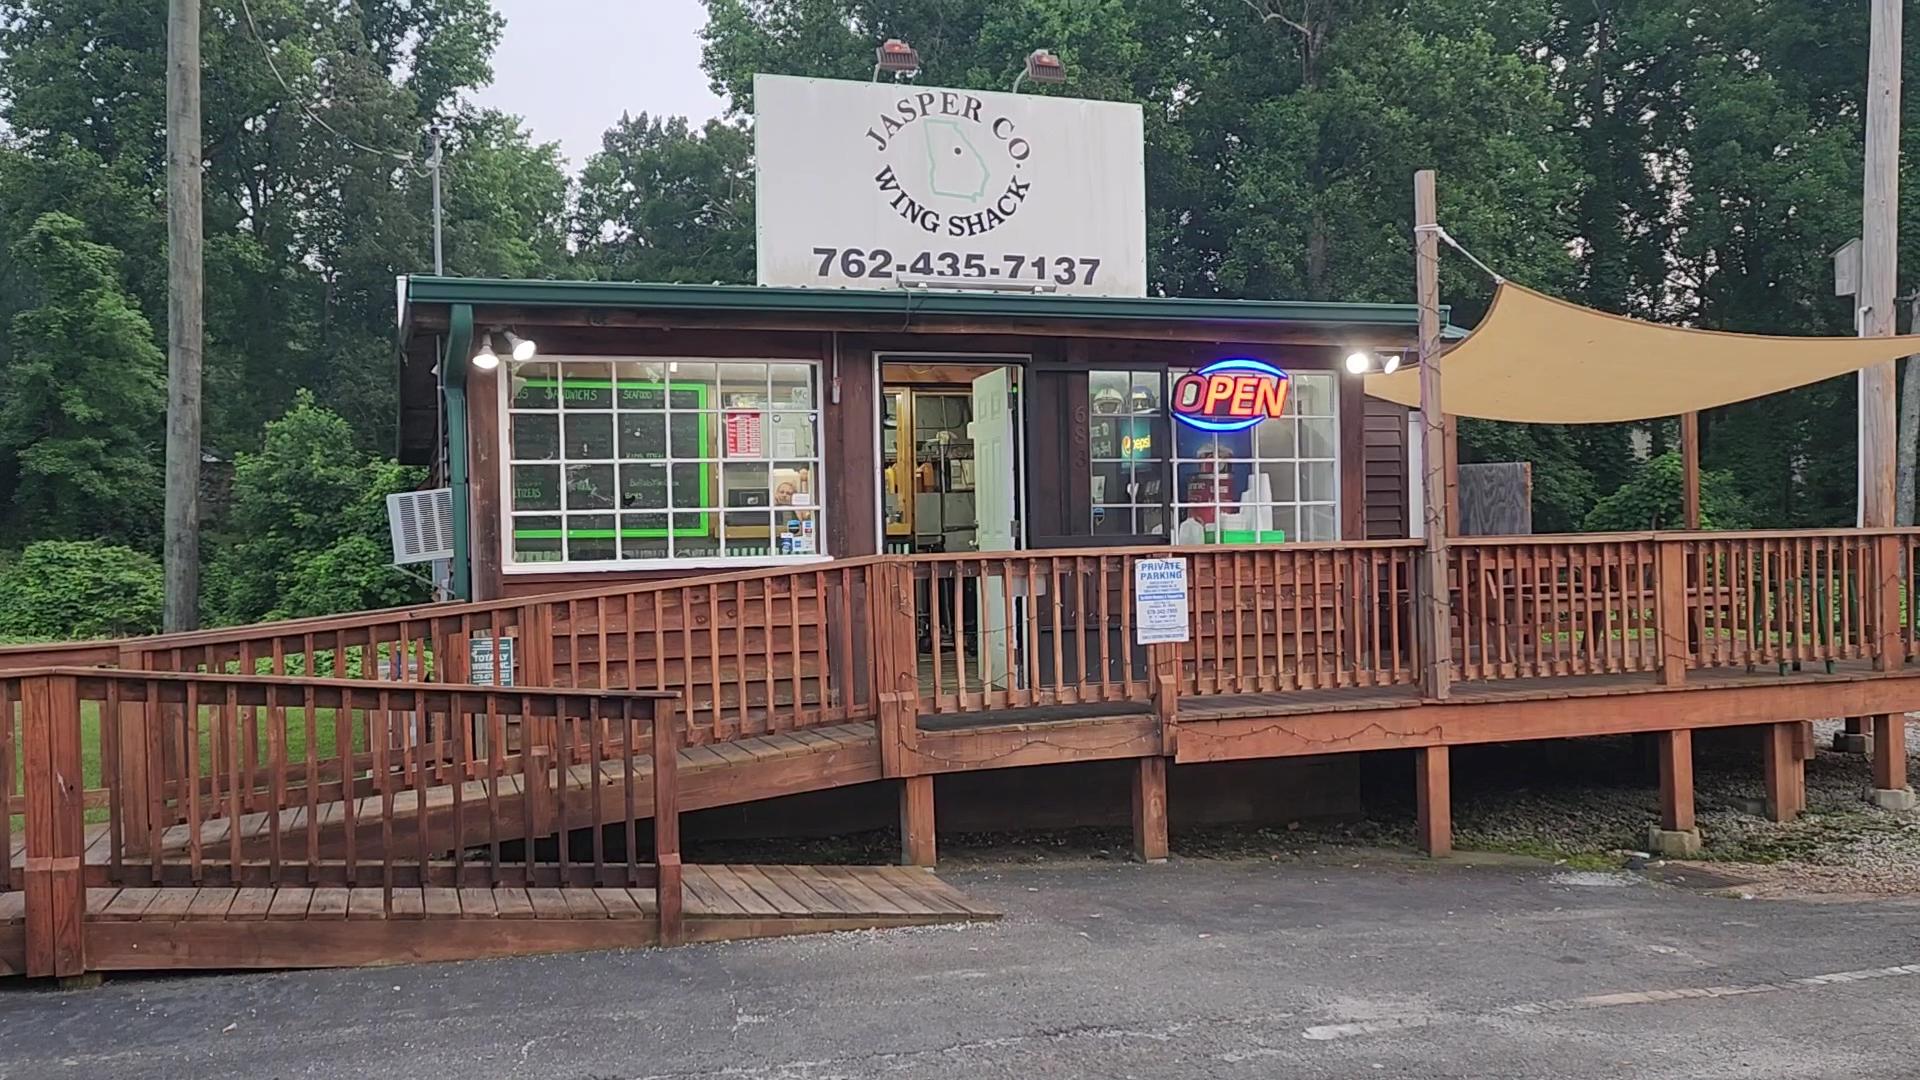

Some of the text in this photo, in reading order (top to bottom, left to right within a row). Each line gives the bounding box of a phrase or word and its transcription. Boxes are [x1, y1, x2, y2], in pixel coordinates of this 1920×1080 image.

[866, 91, 1030, 169] JASPER CO.
[875, 164, 1031, 237] WING SHACK
[813, 248, 1101, 286] 762-435-7137
[1174, 375, 1289, 418] OPEN
[1140, 571, 1182, 580] PARKING
[1141, 562, 1181, 571] PRIVATE
[474, 653, 509, 662] TOTALY
